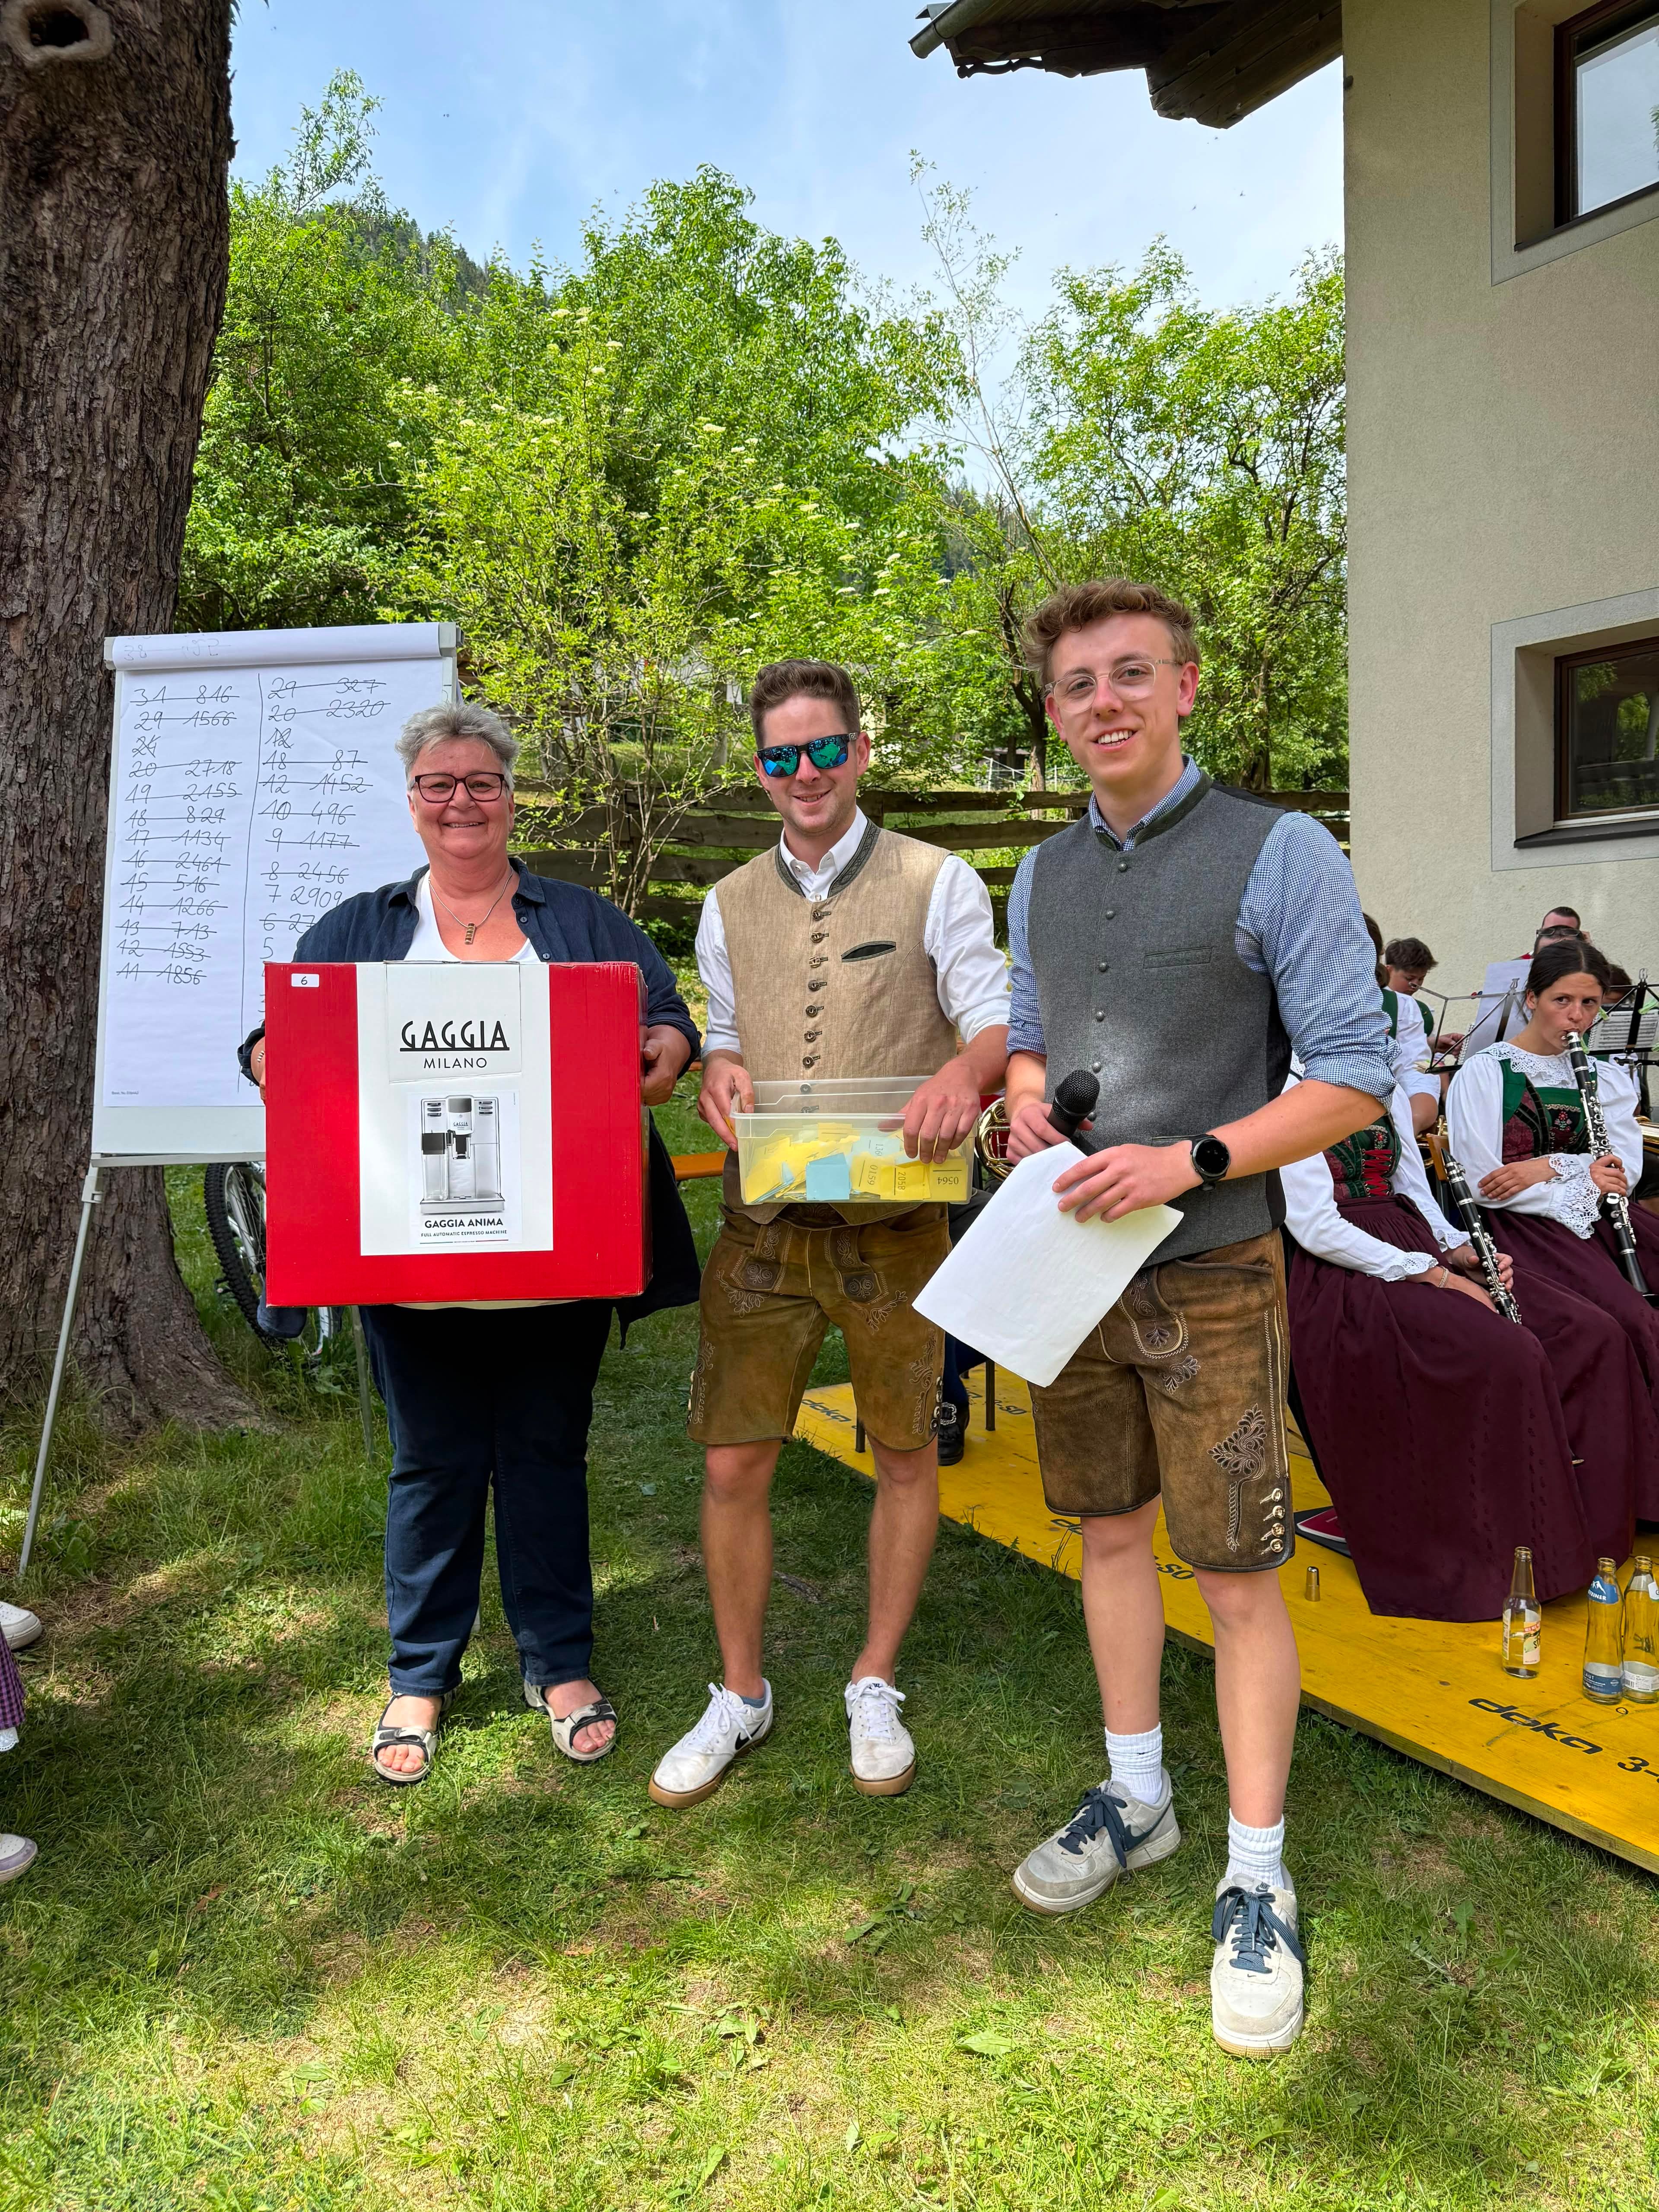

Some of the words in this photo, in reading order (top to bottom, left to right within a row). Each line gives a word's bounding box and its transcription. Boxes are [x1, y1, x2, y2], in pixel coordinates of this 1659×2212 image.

[134, 686, 166, 706] 31
[197, 685, 232, 704] 816
[268, 677, 296, 699] 29
[336, 678, 378, 694] 327
[134, 712, 163, 731] 29
[183, 711, 235, 727] 1566
[268, 705, 296, 721] 20
[326, 699, 384, 718] 2320
[129, 761, 157, 777] 20
[185, 760, 236, 777] 2718
[264, 750, 286, 770] 18
[333, 750, 361, 771] 87
[125, 784, 151, 804] 19
[183, 782, 237, 801] 2155
[263, 774, 290, 794] 12
[310, 773, 366, 795] 1452
[124, 809, 147, 828] 18
[187, 806, 225, 823] 829
[311, 801, 353, 825] 496
[128, 830, 149, 845] 17
[172, 830, 224, 852] 1134
[273, 828, 283, 852] 9
[300, 831, 353, 850] 1177
[127, 849, 149, 868] 16
[176, 852, 222, 873] 2461
[125, 872, 149, 893] 15
[173, 874, 209, 893] 516
[269, 861, 280, 880] 8
[299, 861, 349, 884] 2456
[121, 895, 143, 915] 14
[169, 897, 219, 916] 1266
[264, 884, 282, 903] 7
[291, 886, 343, 908] 2909
[120, 919, 140, 935] 13
[172, 922, 209, 940] 713
[264, 913, 277, 931] 6
[117, 939, 144, 957] 12
[163, 942, 204, 962] 1553
[260, 937, 273, 959] 5
[117, 963, 139, 981] 11
[156, 963, 203, 985] 1856
[301, 976, 308, 985] 6
[400, 1020, 510, 1052] GAGGIA
[423, 1058, 487, 1068] MILANO
[867, 1164, 878, 1185] 0159
[898, 1171, 906, 1190] 2058
[937, 1176, 959, 1185] 0564
[425, 1219, 465, 1229] GAGGIA
[467, 1217, 504, 1227] ANIMA
[1468, 1698, 1603, 1755] doka
[1617, 1756, 1659, 1783] 3-
